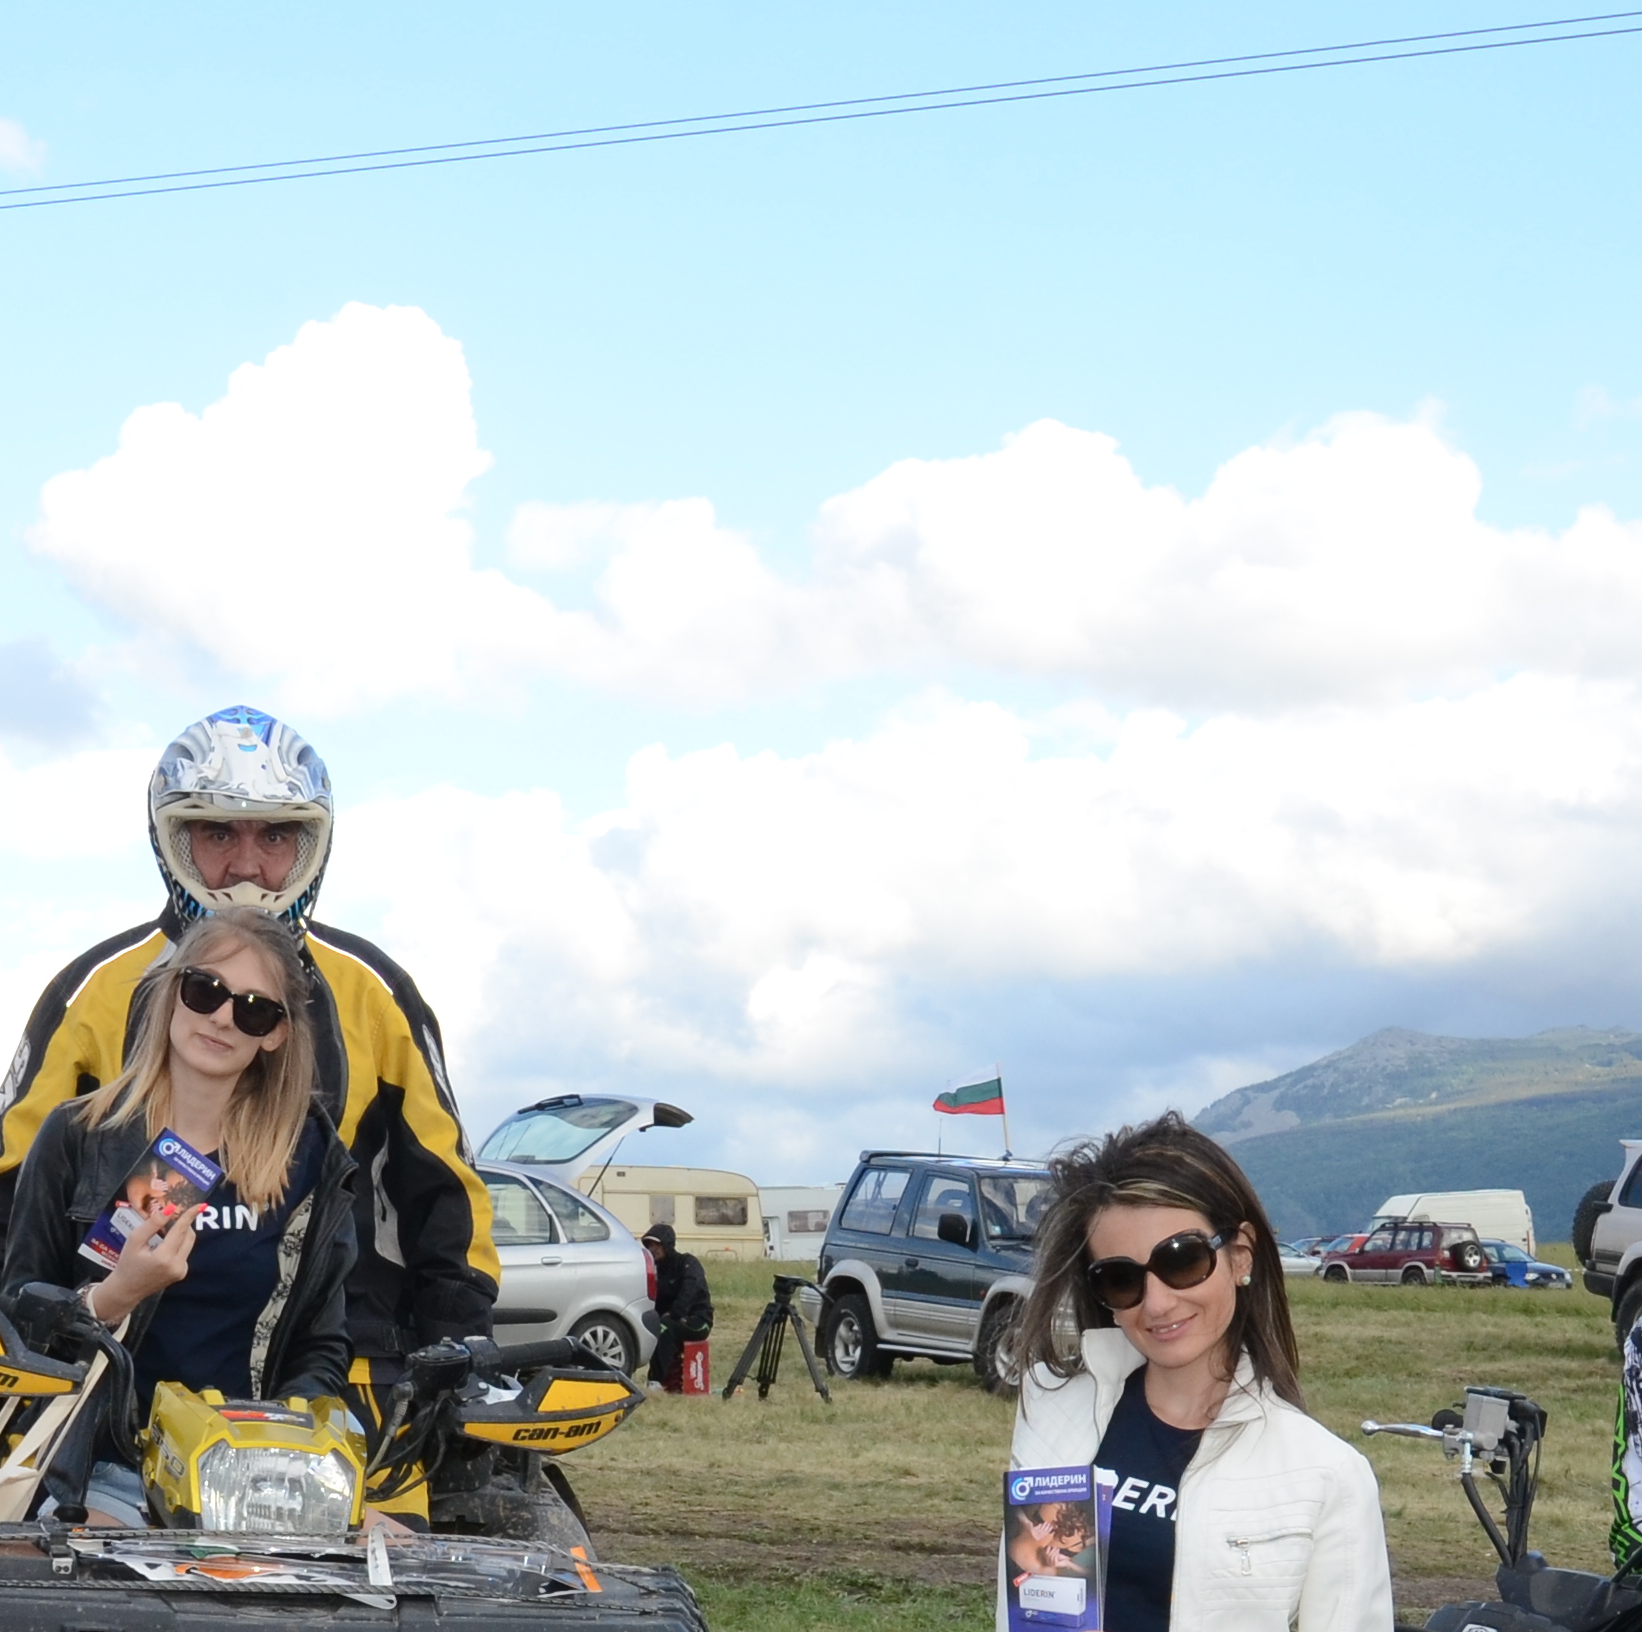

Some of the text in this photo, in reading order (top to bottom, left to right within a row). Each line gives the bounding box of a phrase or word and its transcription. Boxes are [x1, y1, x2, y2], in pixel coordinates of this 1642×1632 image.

[176, 1146, 216, 1181] ЛИДЕРИН
[196, 1202, 258, 1231] RIN
[512, 1421, 602, 1441] can-am
[1034, 1473, 1087, 1488] ЛИДЕРИН
[1023, 1588, 1055, 1599] LIDERIN
